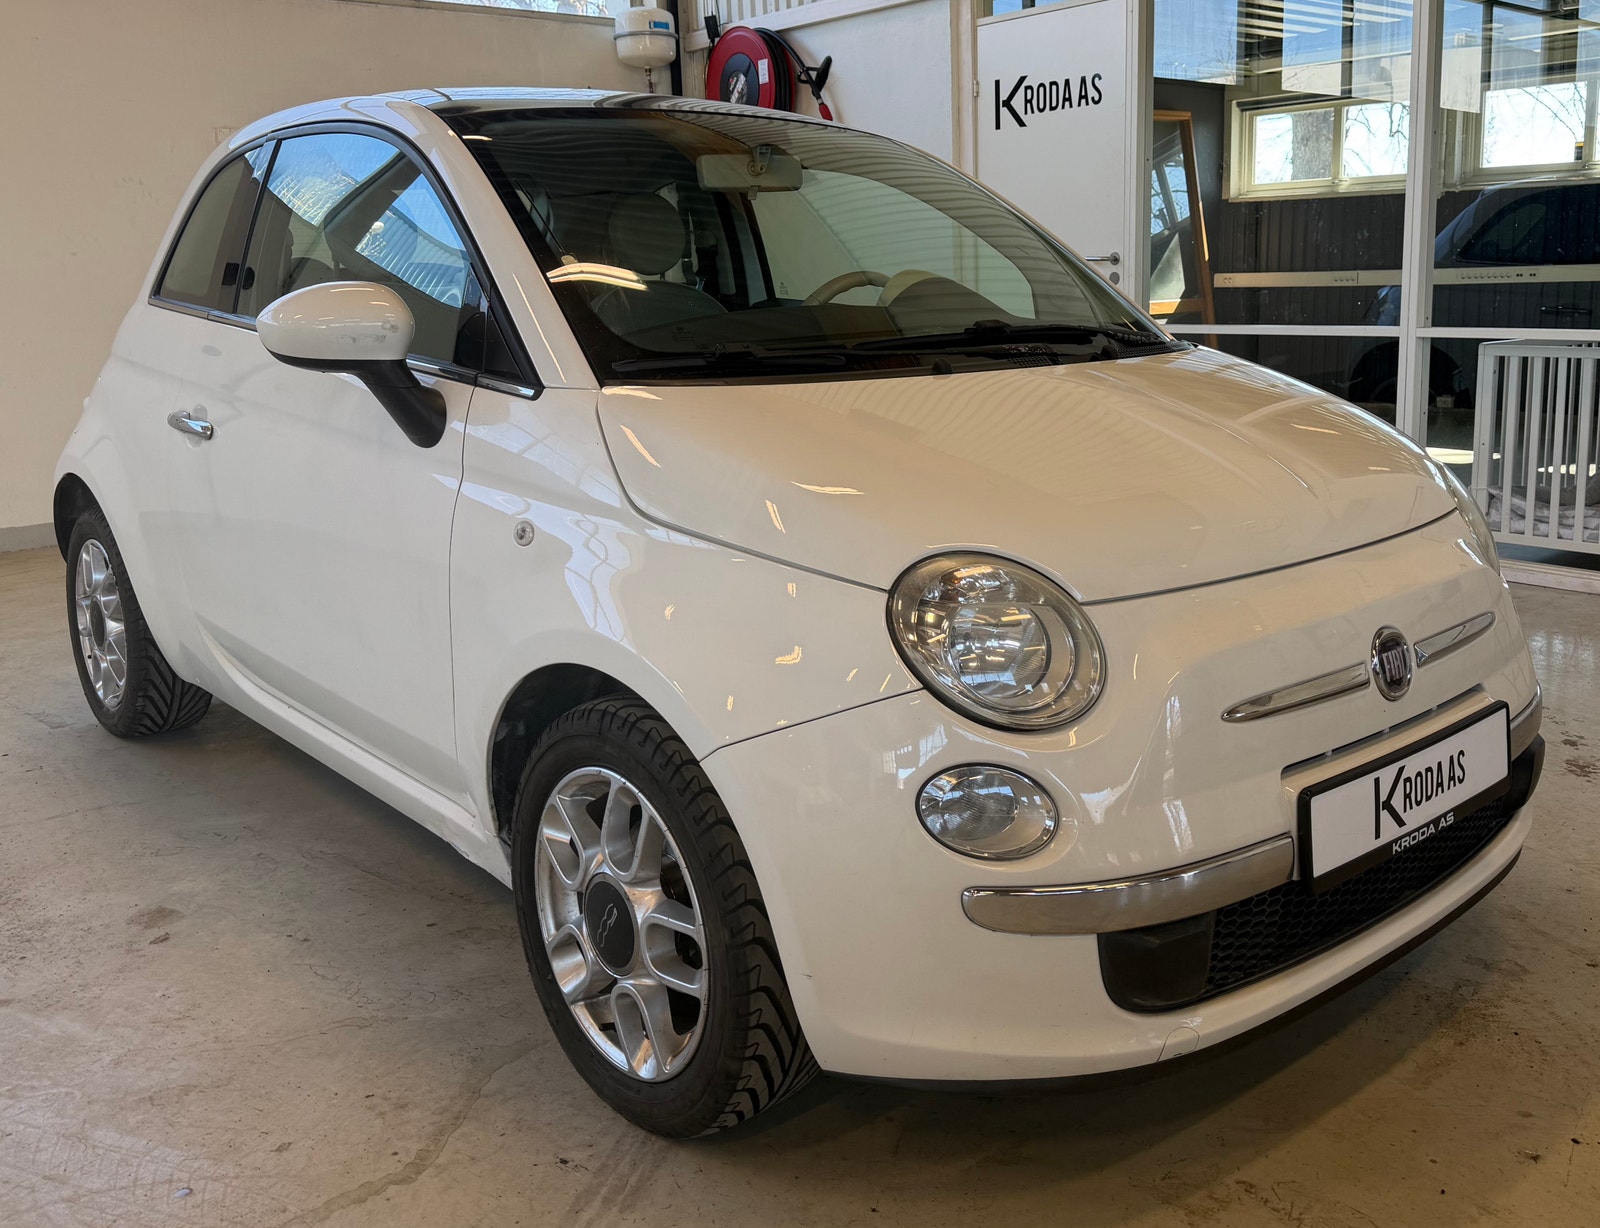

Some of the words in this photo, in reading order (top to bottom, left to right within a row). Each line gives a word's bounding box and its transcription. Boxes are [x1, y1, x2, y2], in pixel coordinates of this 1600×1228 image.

[994, 74, 1073, 130] KRODA
[1077, 73, 1103, 107] AS
[1381, 645, 1406, 682] FIAT
[1374, 761, 1444, 840] KRODA
[1447, 749, 1466, 791] AS
[1392, 823, 1435, 855] KRODA
[1438, 811, 1455, 830] AS
